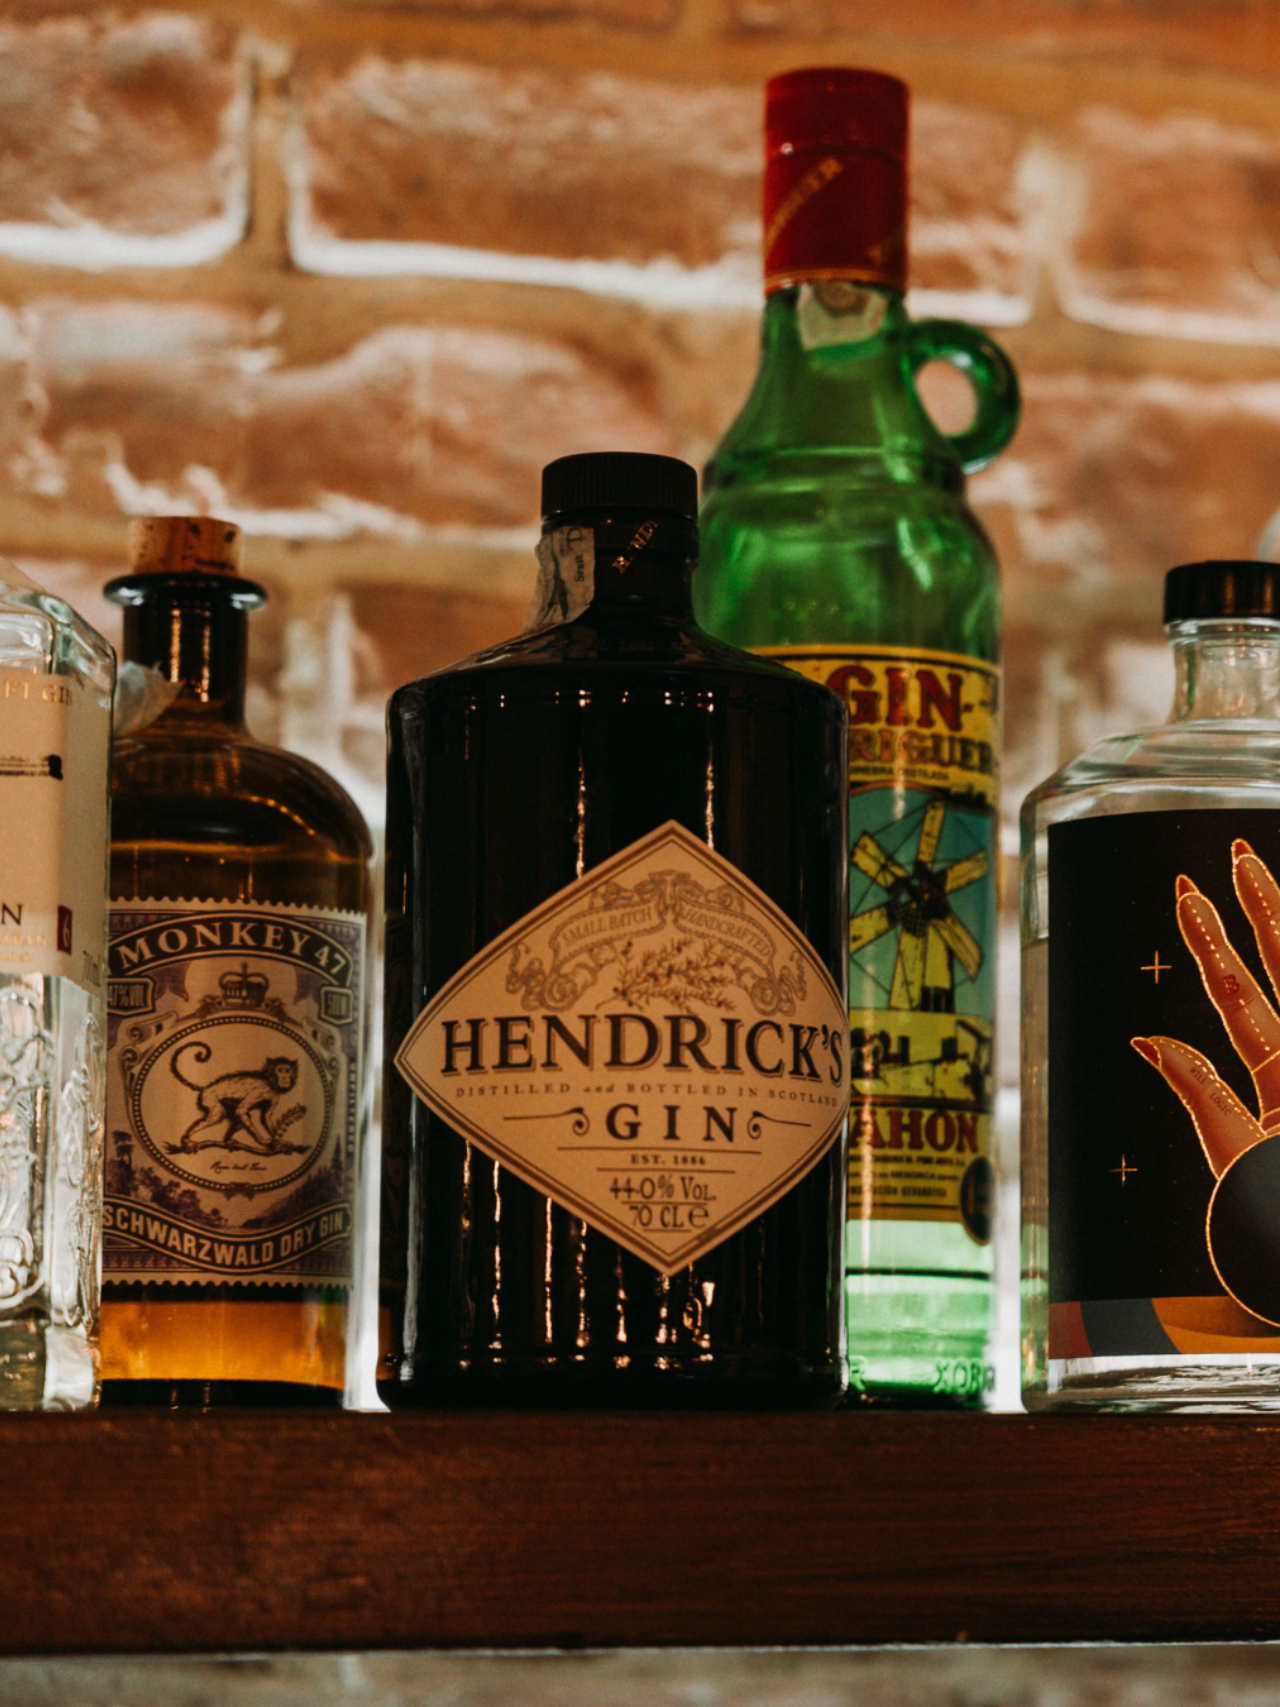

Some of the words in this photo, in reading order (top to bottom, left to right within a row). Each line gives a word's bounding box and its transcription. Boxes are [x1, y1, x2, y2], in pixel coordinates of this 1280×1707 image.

[826, 664, 964, 732] GIN
[116, 921, 312, 968] MONKEY
[314, 945, 347, 975] 47
[440, 1013, 845, 1088] HENDRICK'S
[456, 1083, 570, 1097] DISTILLED
[583, 1083, 615, 1093] and
[627, 1083, 727, 1096] BOTTLED
[738, 1086, 758, 1097] IN
[769, 1089, 837, 1107] SCOTLAND
[605, 1103, 737, 1142] GIN
[850, 1109, 979, 1153] AHON
[102, 1206, 275, 1267] SCHWARZWALD
[280, 1226, 316, 1258] DRY
[319, 1211, 344, 1238] GIN
[629, 1204, 653, 1228] 70
